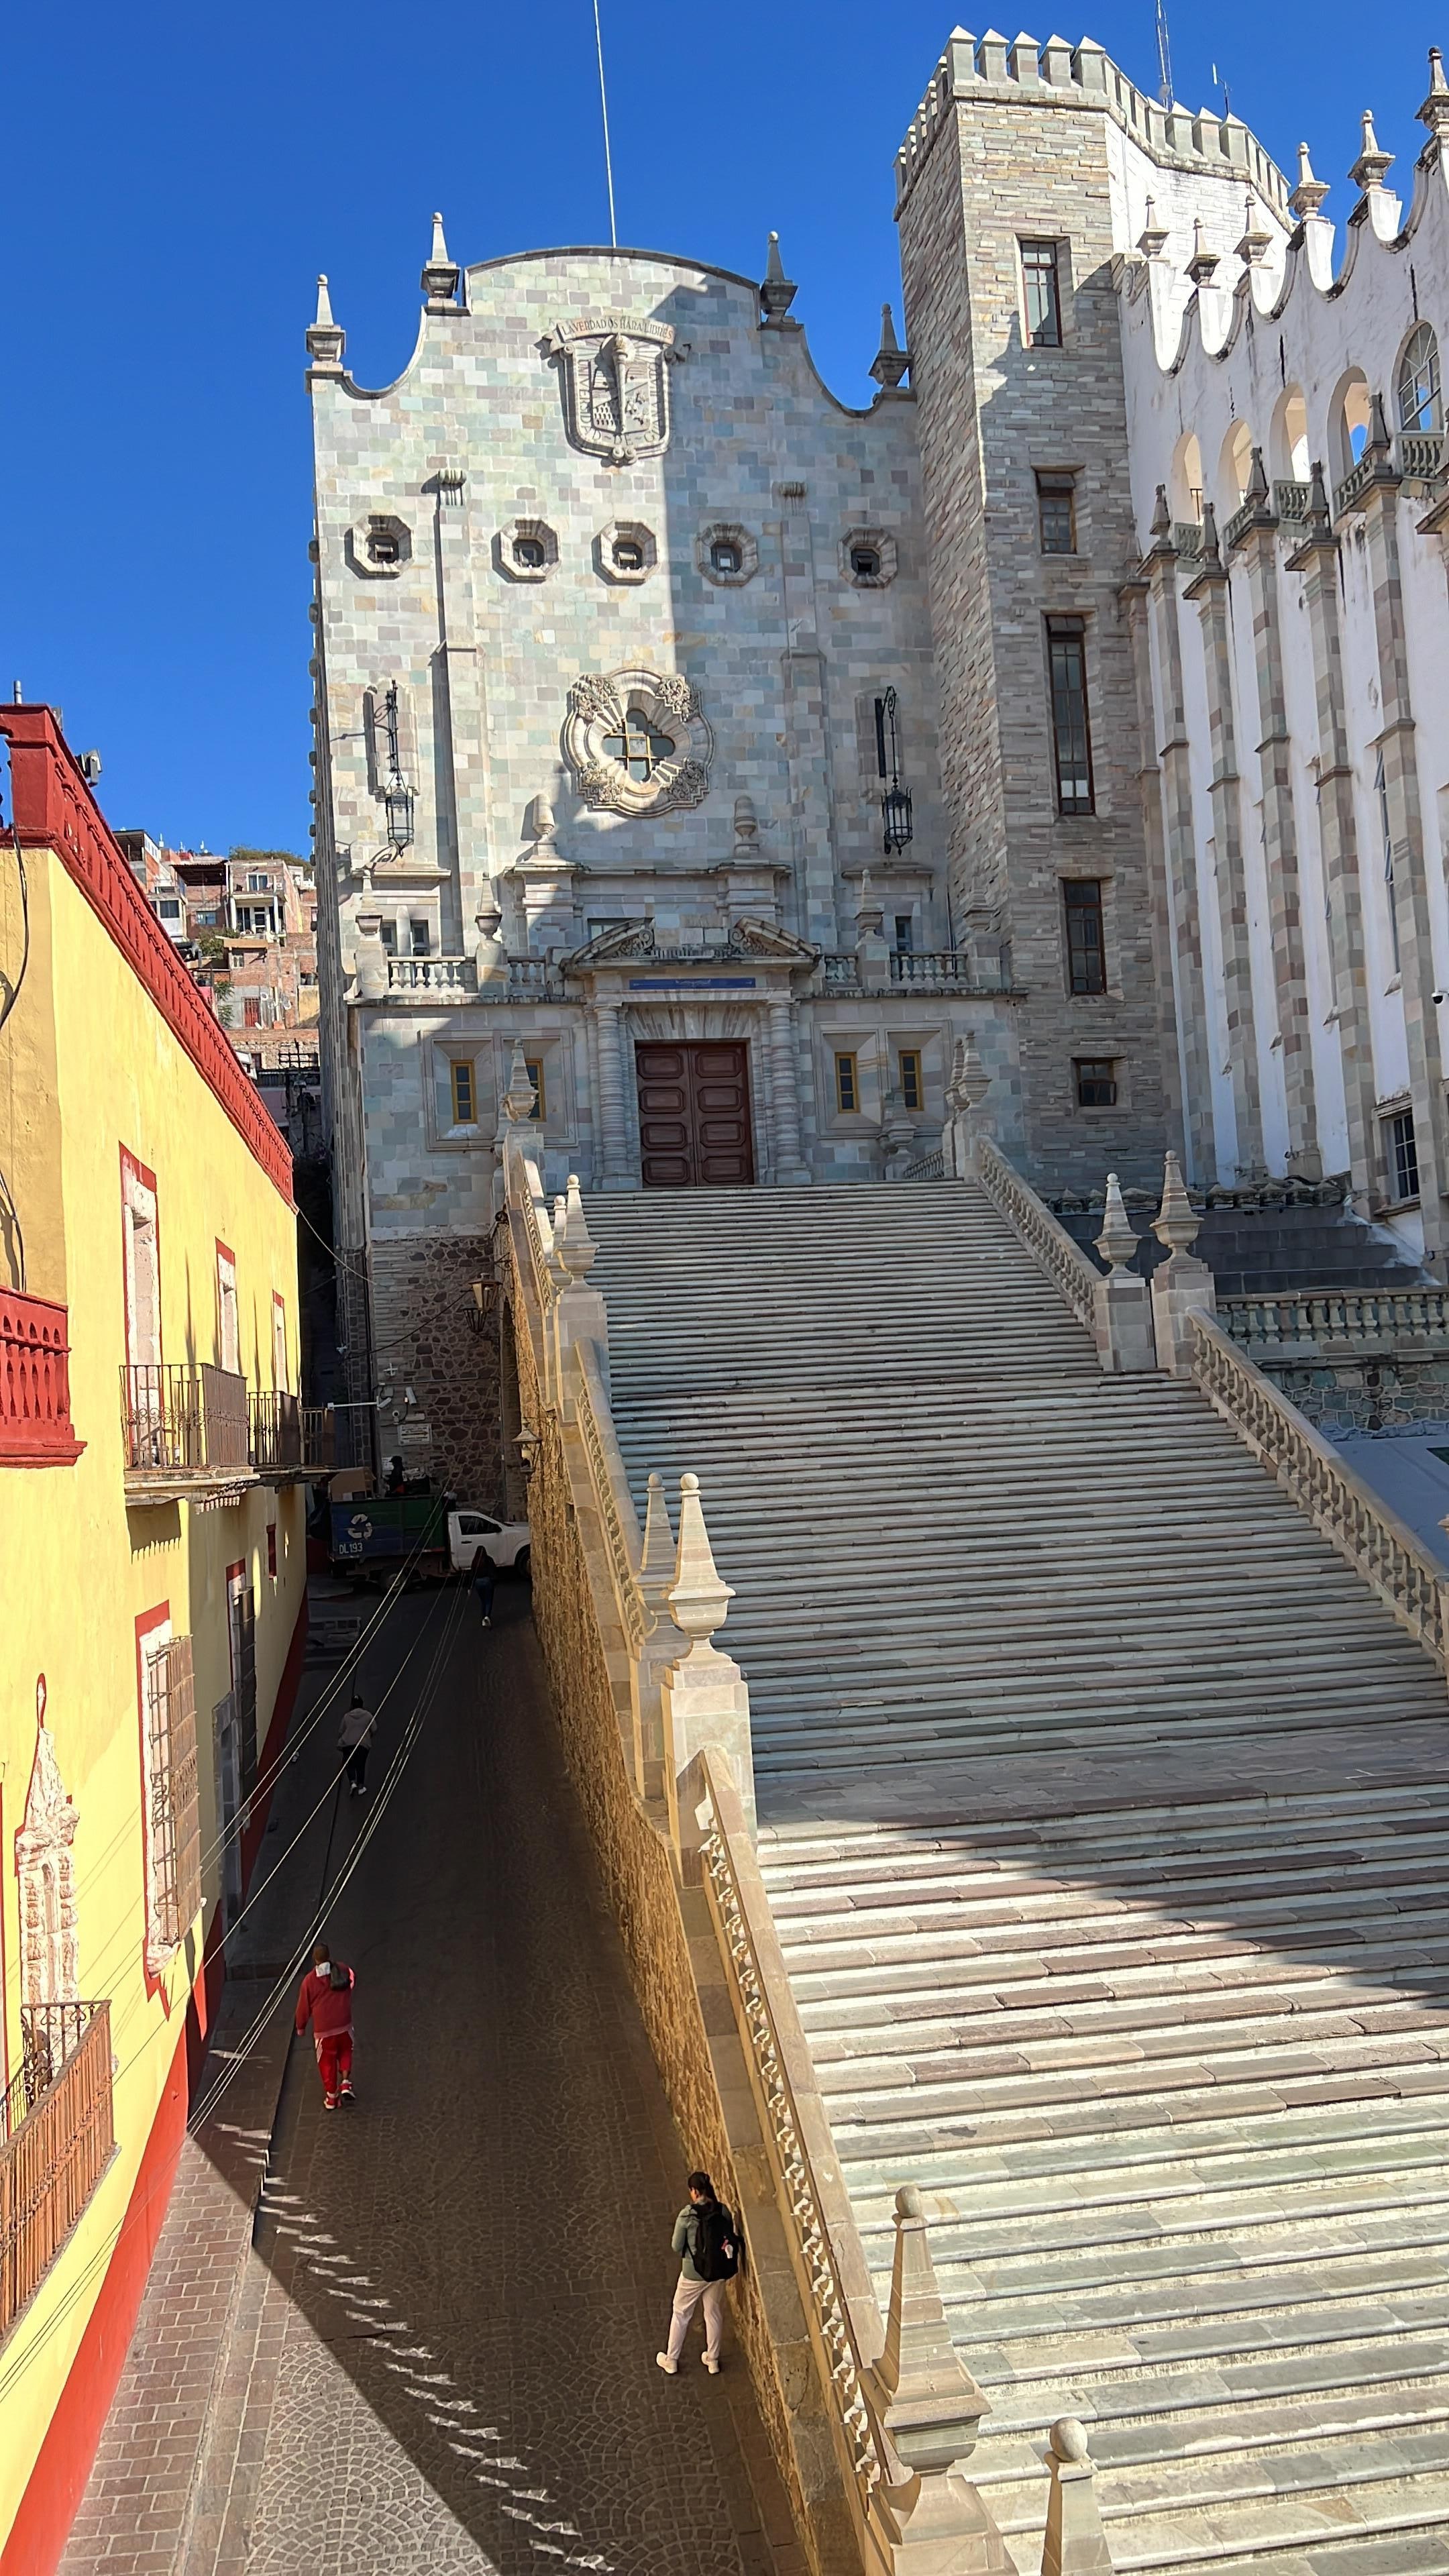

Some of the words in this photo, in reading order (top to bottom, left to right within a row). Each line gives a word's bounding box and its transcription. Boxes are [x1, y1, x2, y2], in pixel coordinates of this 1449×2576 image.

[561, 325, 574, 335] LA
[572, 320, 606, 333] VERDAD
[608, 319, 618, 329] OS
[644, 323, 674, 339] LIBRES
[578, 360, 601, 441] UNIVERSIDAD
[614, 434, 634, 445] DE
[339, 1543, 349, 1554] DL
[350, 1542, 363, 1553] 193
